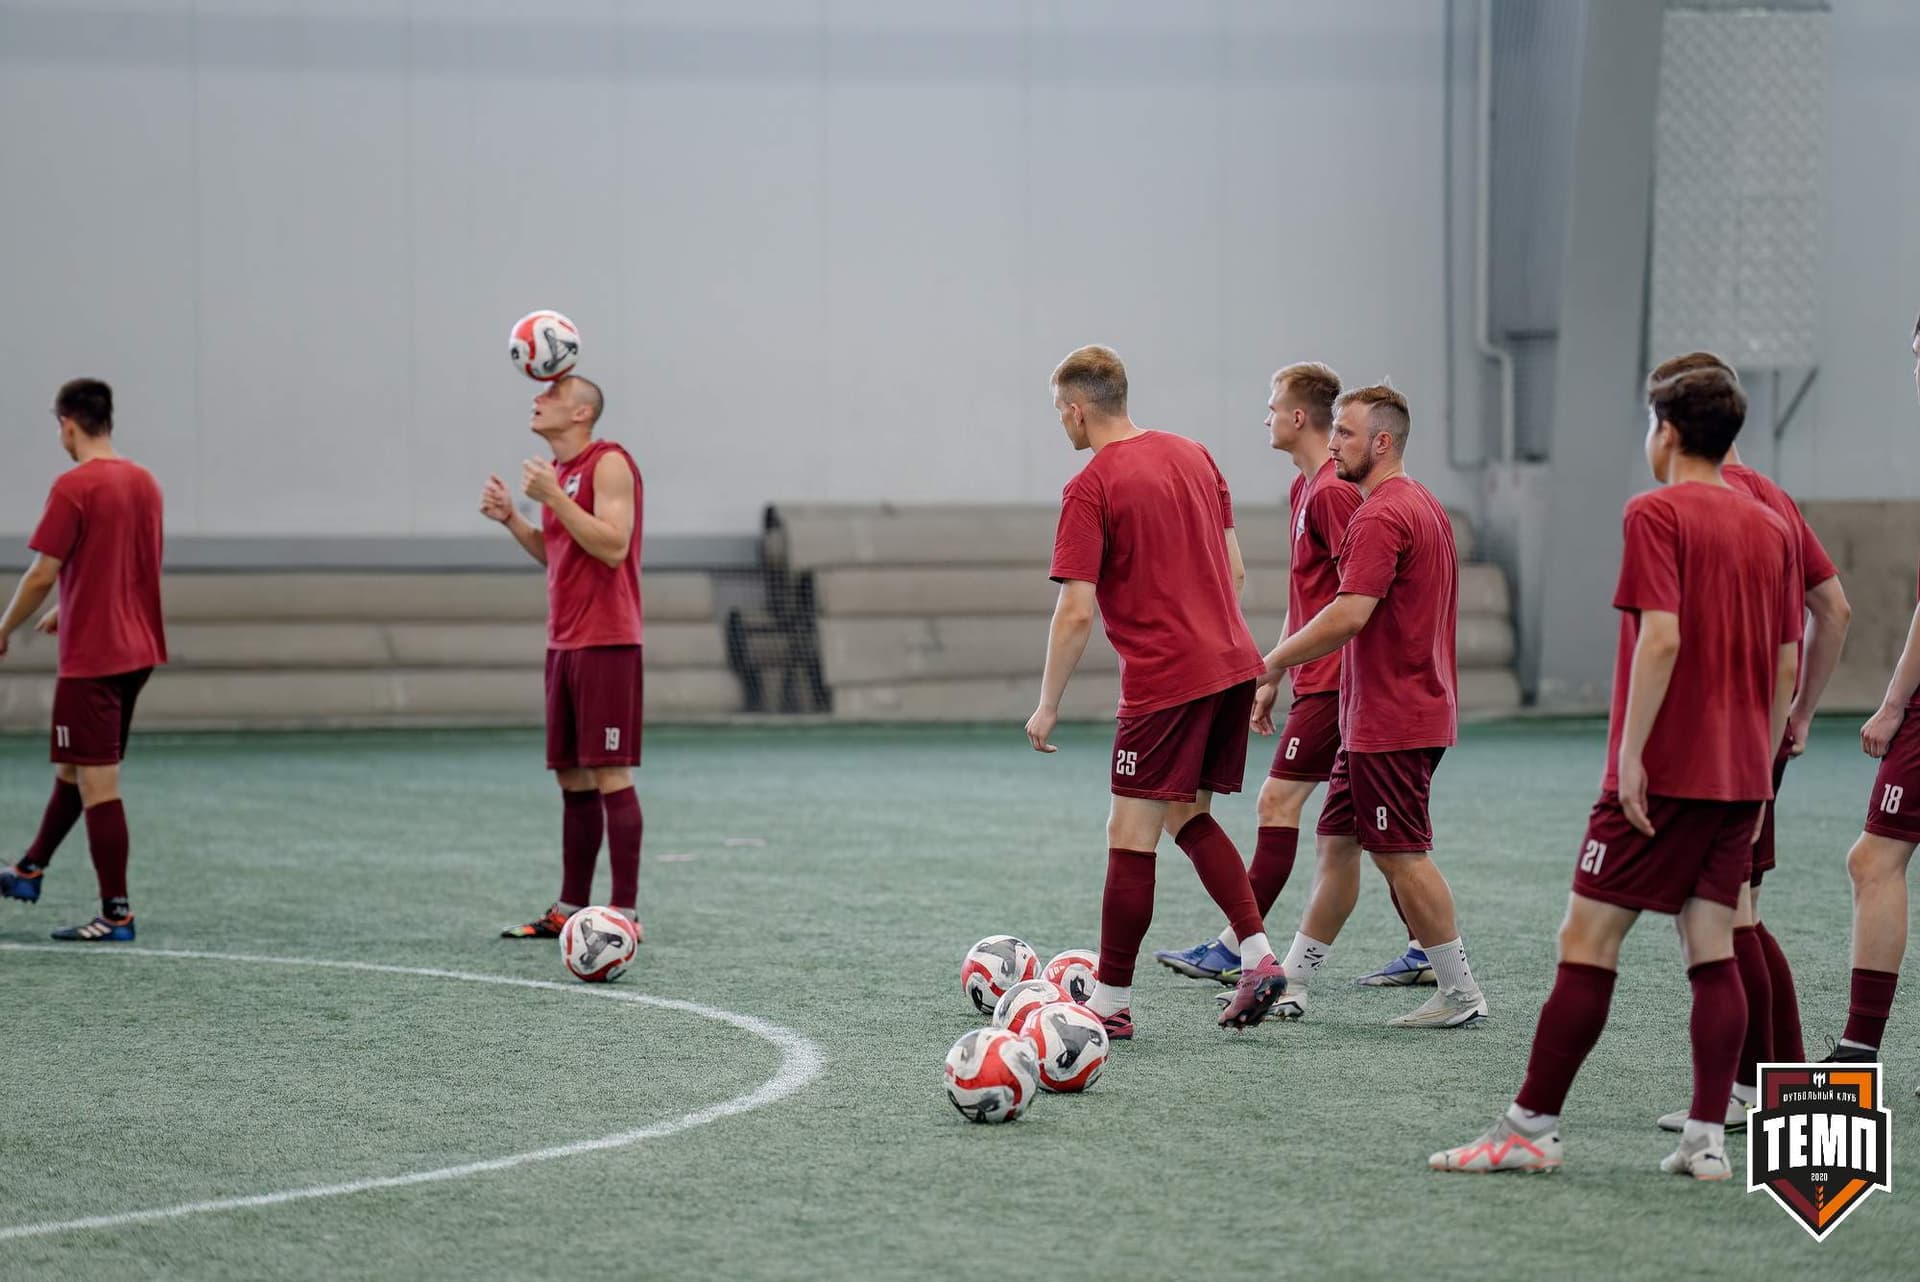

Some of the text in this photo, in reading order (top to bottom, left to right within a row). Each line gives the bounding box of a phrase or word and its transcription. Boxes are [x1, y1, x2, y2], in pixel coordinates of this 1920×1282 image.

[56, 726, 71, 748] 11
[604, 726, 621, 751] 19
[1285, 736, 1301, 761] 6
[1115, 749, 1138, 776] 25
[1879, 783, 1904, 815] 18
[1375, 805, 1388, 831] 8
[1579, 838, 1608, 876] 21
